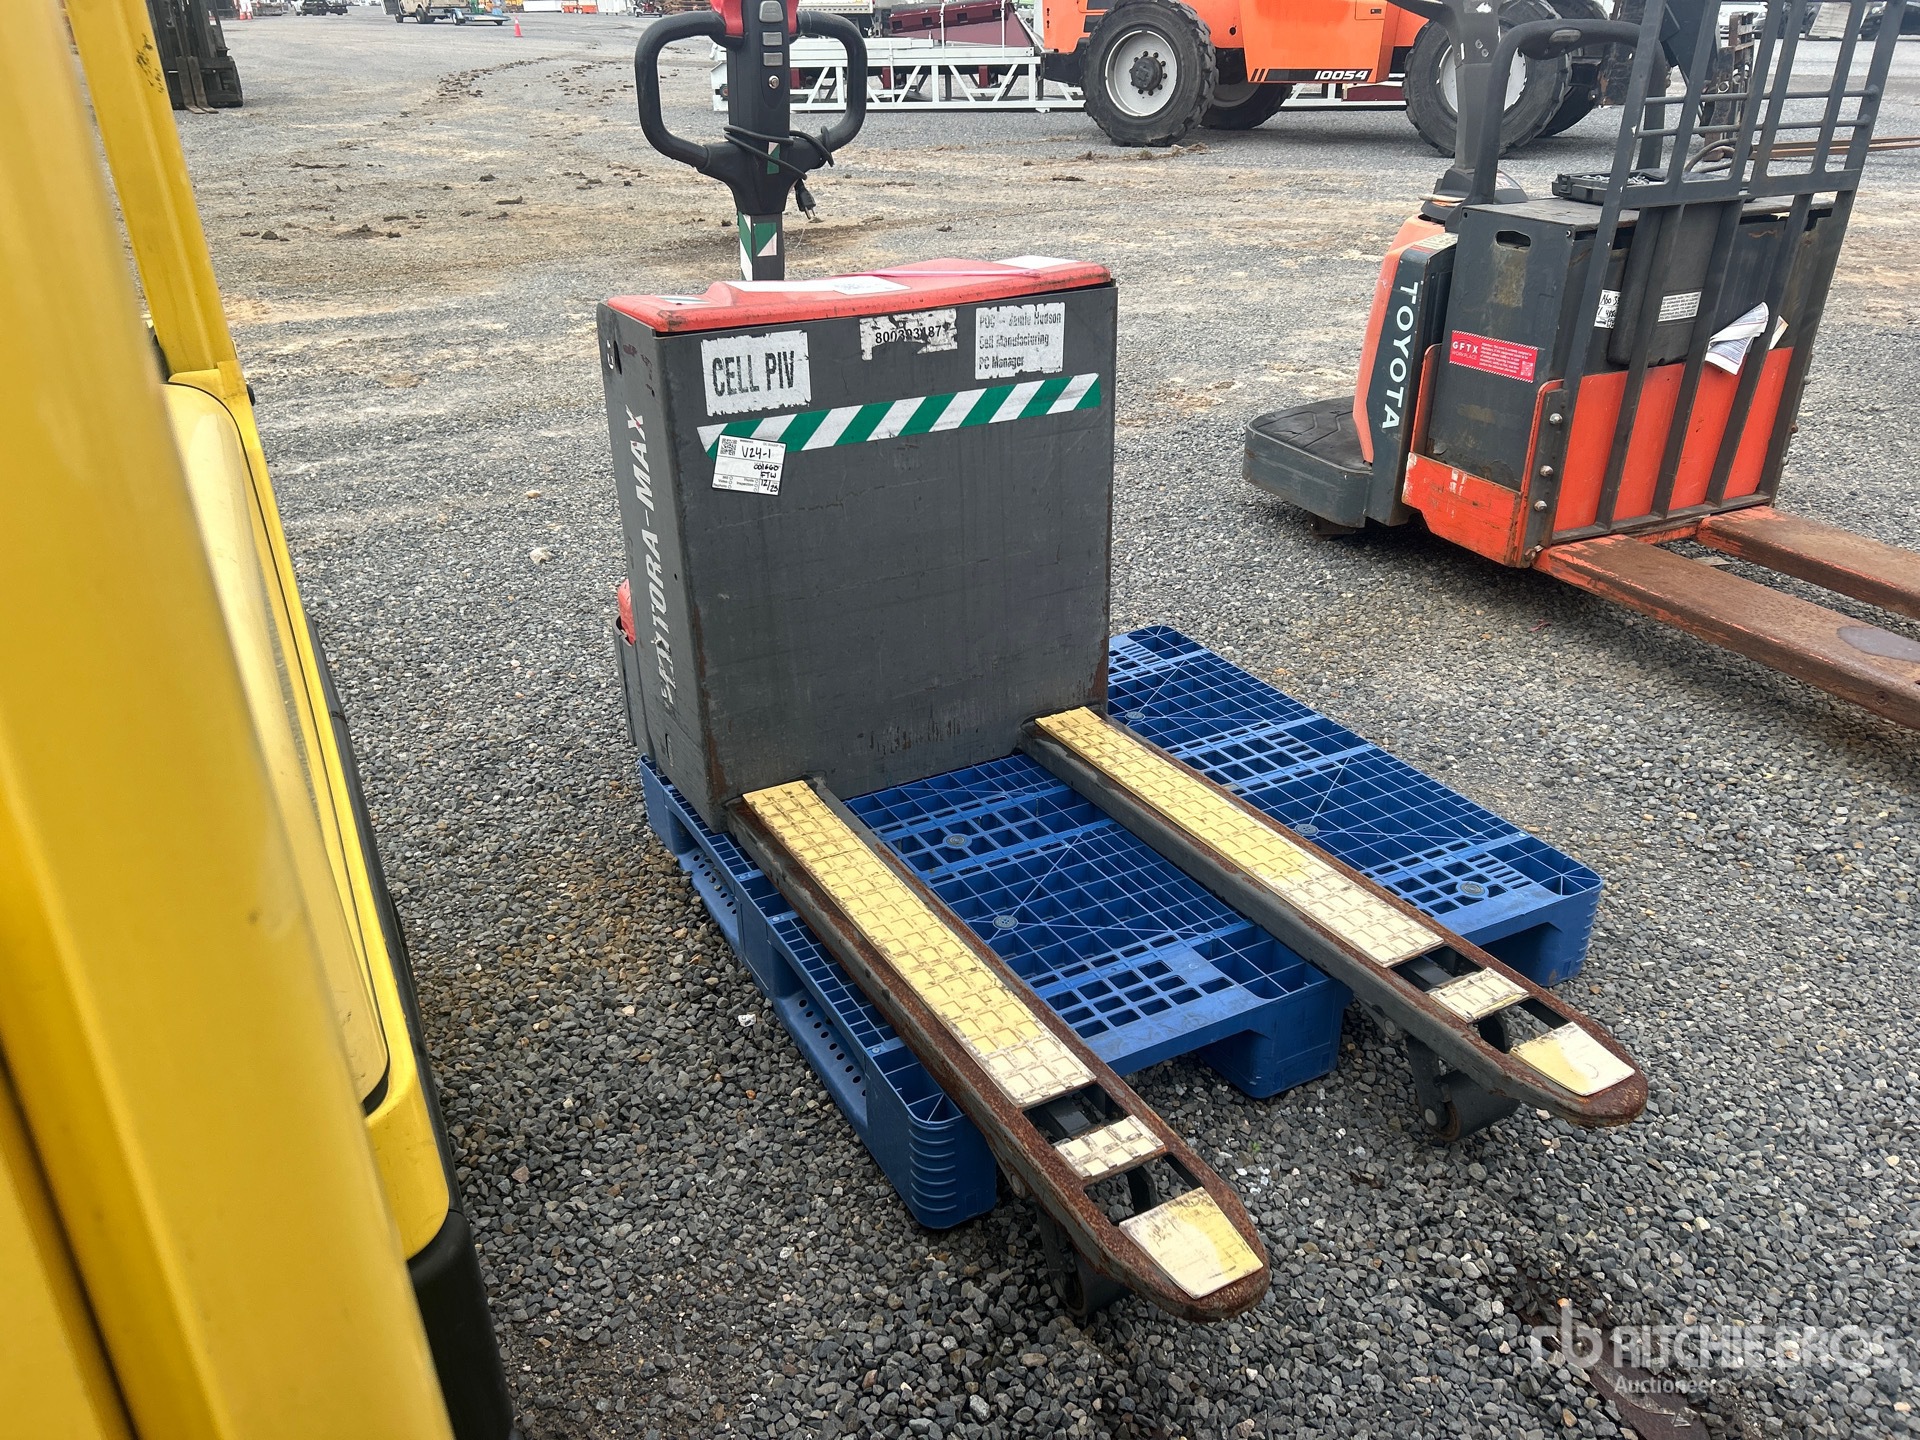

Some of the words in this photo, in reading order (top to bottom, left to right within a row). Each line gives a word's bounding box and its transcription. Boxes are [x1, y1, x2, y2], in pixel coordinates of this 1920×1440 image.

[1314, 70, 1369, 80] 10054
[1452, 341, 1479, 354] GFTX
[1382, 281, 1419, 429] TOYOTA
[992, 355, 1025, 370] Manager
[712, 354, 760, 397] CELL
[765, 350, 795, 391] PIV
[742, 446, 771, 460] V24-1
[760, 471, 777, 479] FTW
